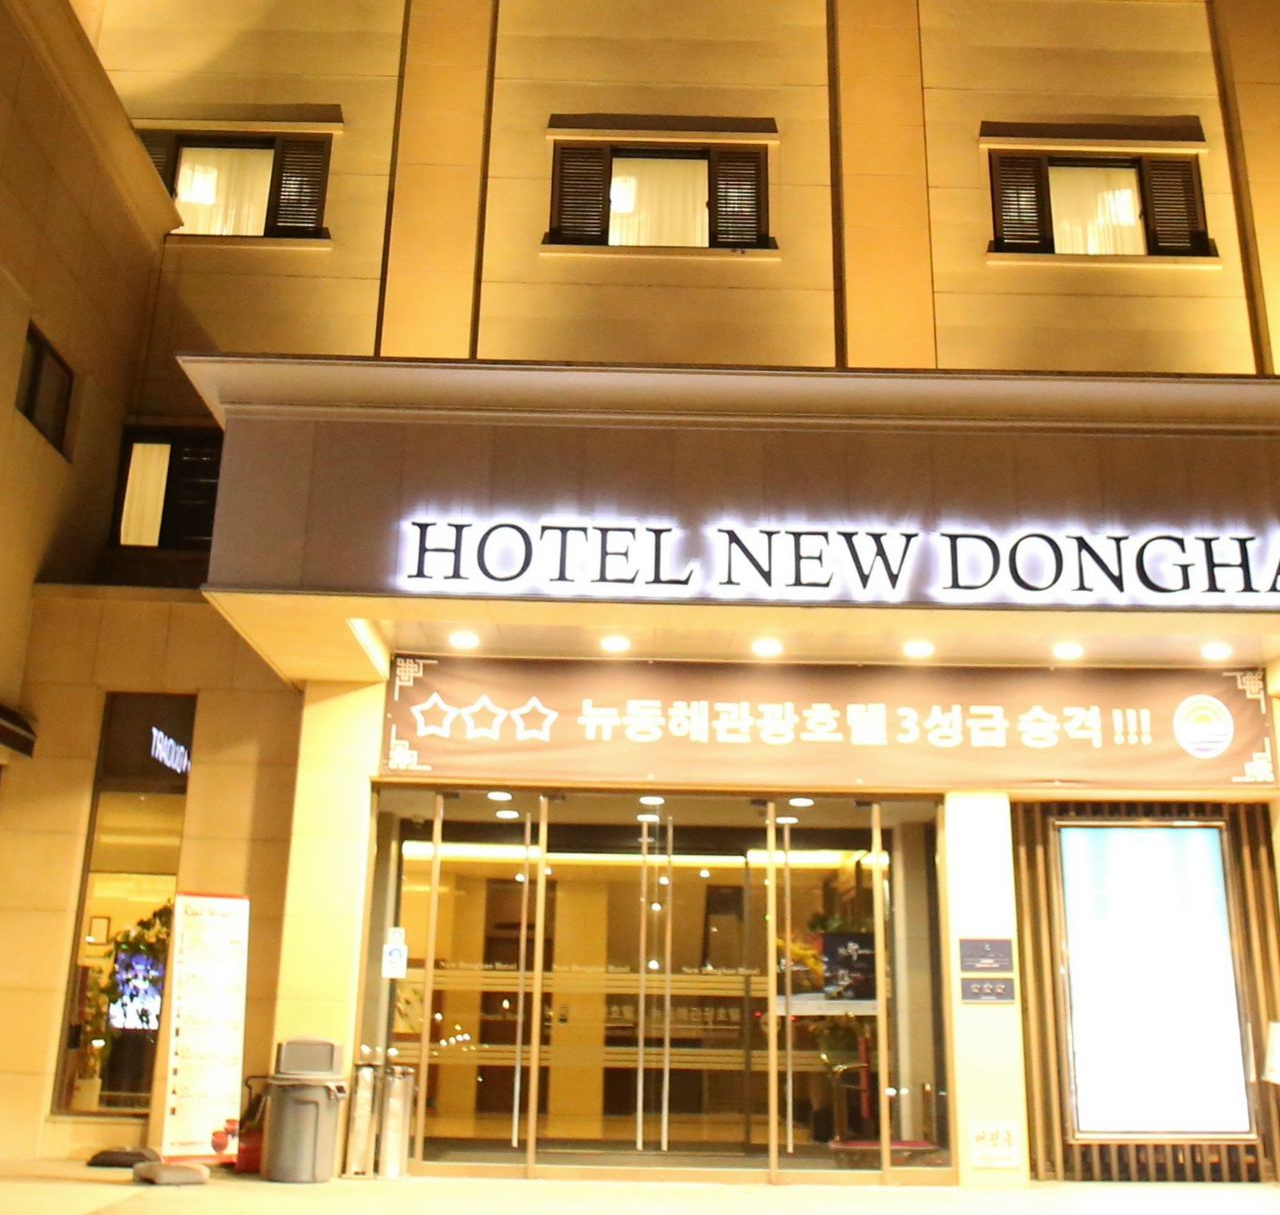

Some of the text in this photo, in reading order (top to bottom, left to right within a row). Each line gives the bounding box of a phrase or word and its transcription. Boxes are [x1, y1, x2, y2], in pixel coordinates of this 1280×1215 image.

[406, 521, 695, 586] HOTEL
[716, 528, 920, 590] NEW
[576, 697, 1153, 748] 뉴동해관광호텔 3성급 승격 !!!
